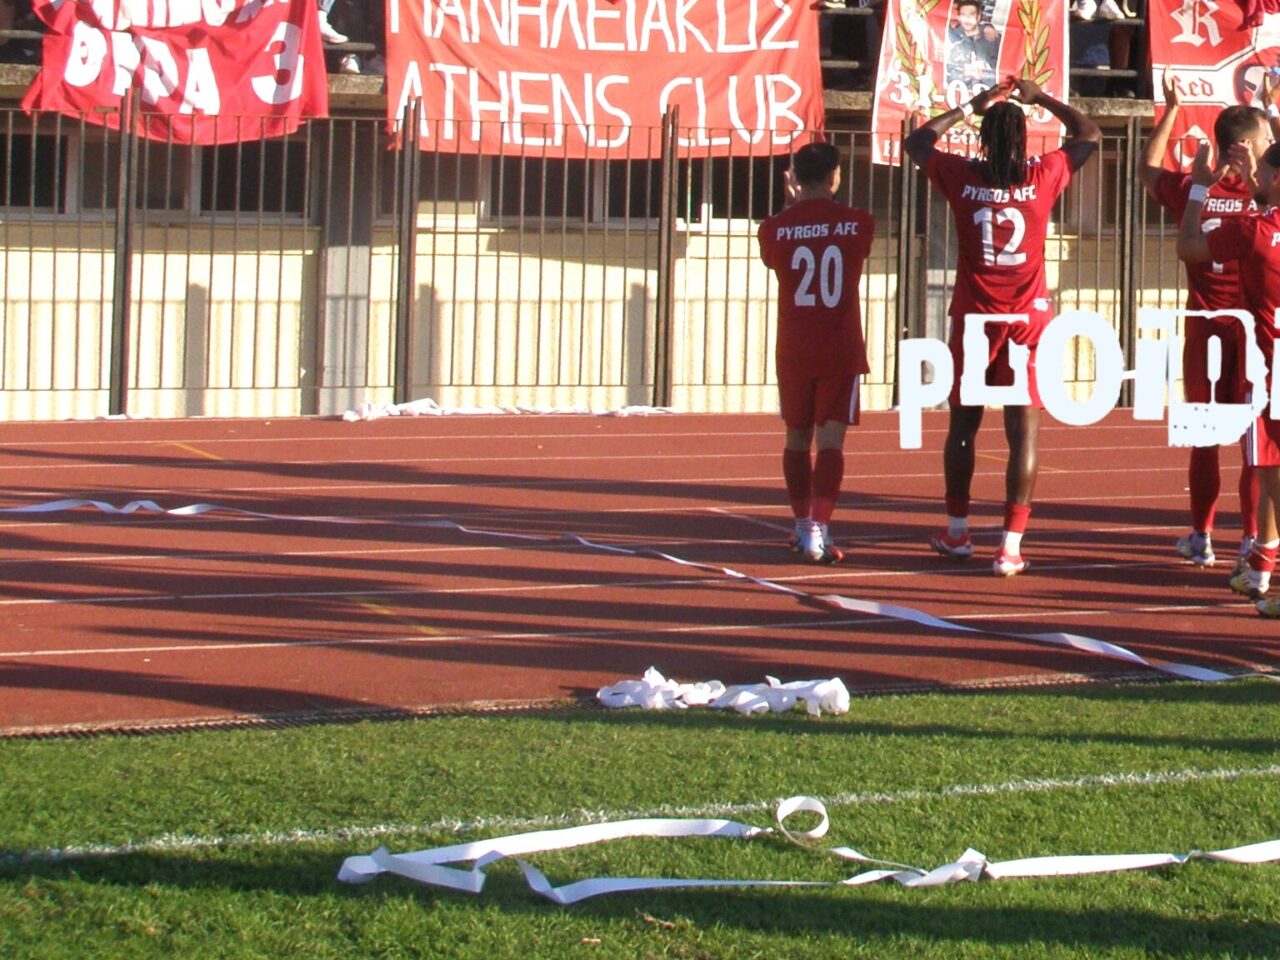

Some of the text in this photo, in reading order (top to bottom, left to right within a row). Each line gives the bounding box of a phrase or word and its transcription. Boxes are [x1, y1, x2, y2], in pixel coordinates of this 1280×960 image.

[251, 21, 304, 105] 3
[393, 61, 632, 148] ATHENS
[660, 73, 805, 148] CLUB
[962, 185, 1036, 204] PYRGOS AFC
[1203, 198, 1244, 212] RGOS
[776, 222, 858, 241] PYRGOS AFC
[973, 207, 1027, 267] 12
[791, 245, 843, 309] 20
